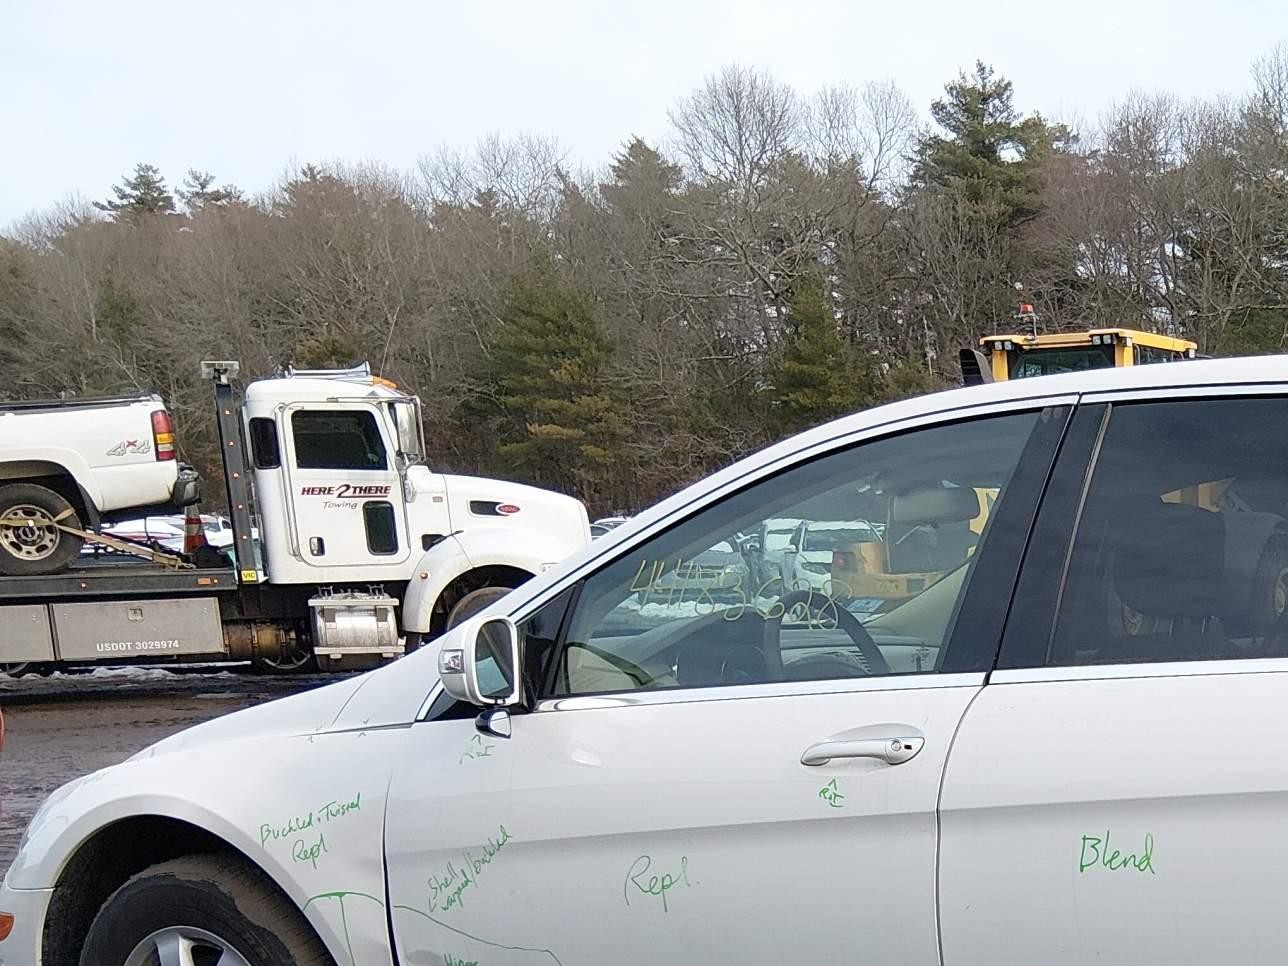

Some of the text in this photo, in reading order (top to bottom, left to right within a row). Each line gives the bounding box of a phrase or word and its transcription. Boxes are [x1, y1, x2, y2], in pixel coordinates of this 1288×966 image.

[322, 501, 358, 510] Towing
[96, 640, 180, 652] USDOT 3029974
[1079, 830, 1156, 875] Blend
